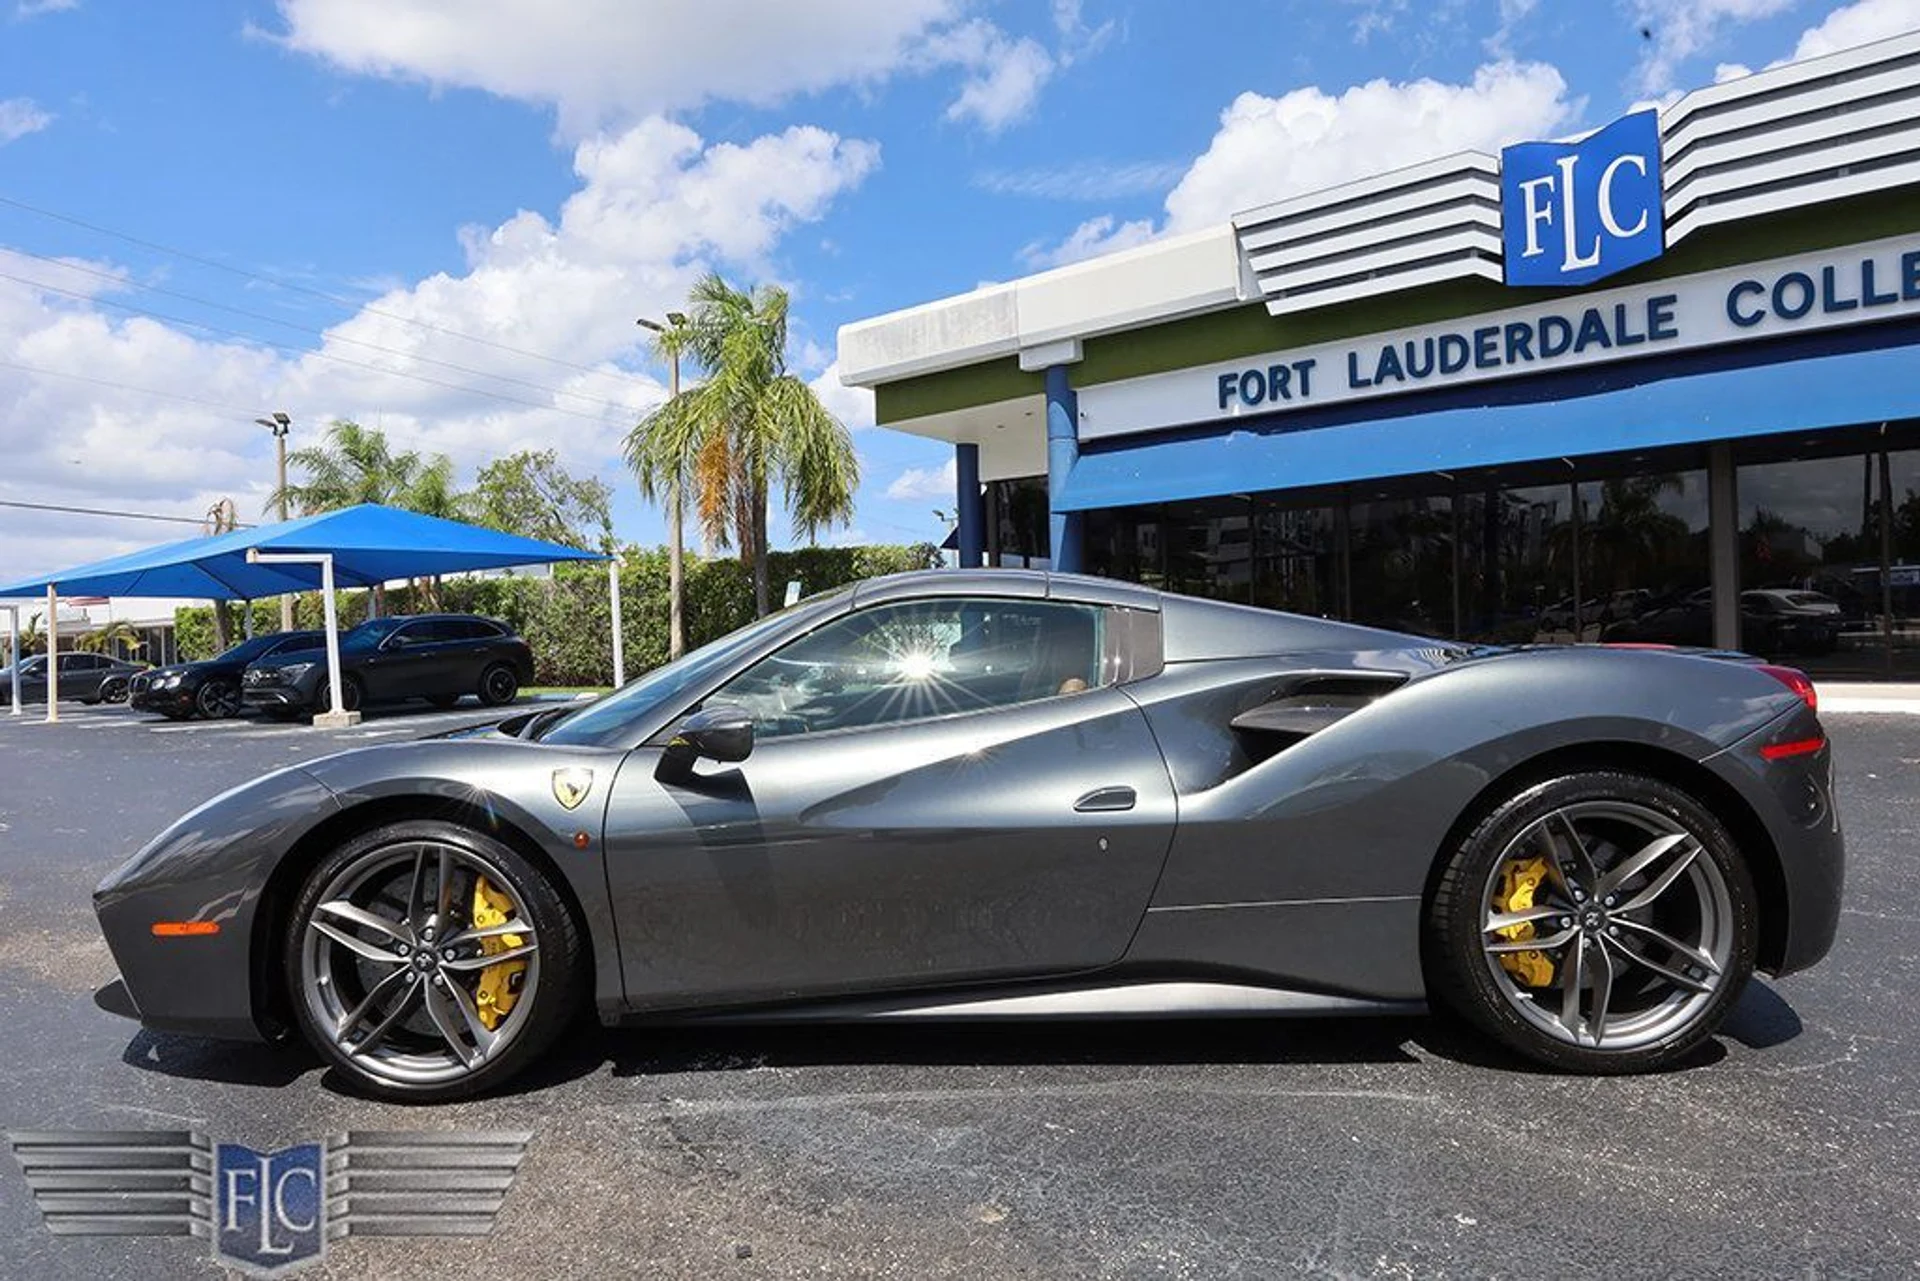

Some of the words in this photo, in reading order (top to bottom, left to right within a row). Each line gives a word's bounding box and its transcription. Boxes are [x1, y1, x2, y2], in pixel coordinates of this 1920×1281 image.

[1519, 155, 1647, 272] FLC
[1218, 359, 1316, 409] FORT
[1348, 294, 1679, 389] LAUDERDALE
